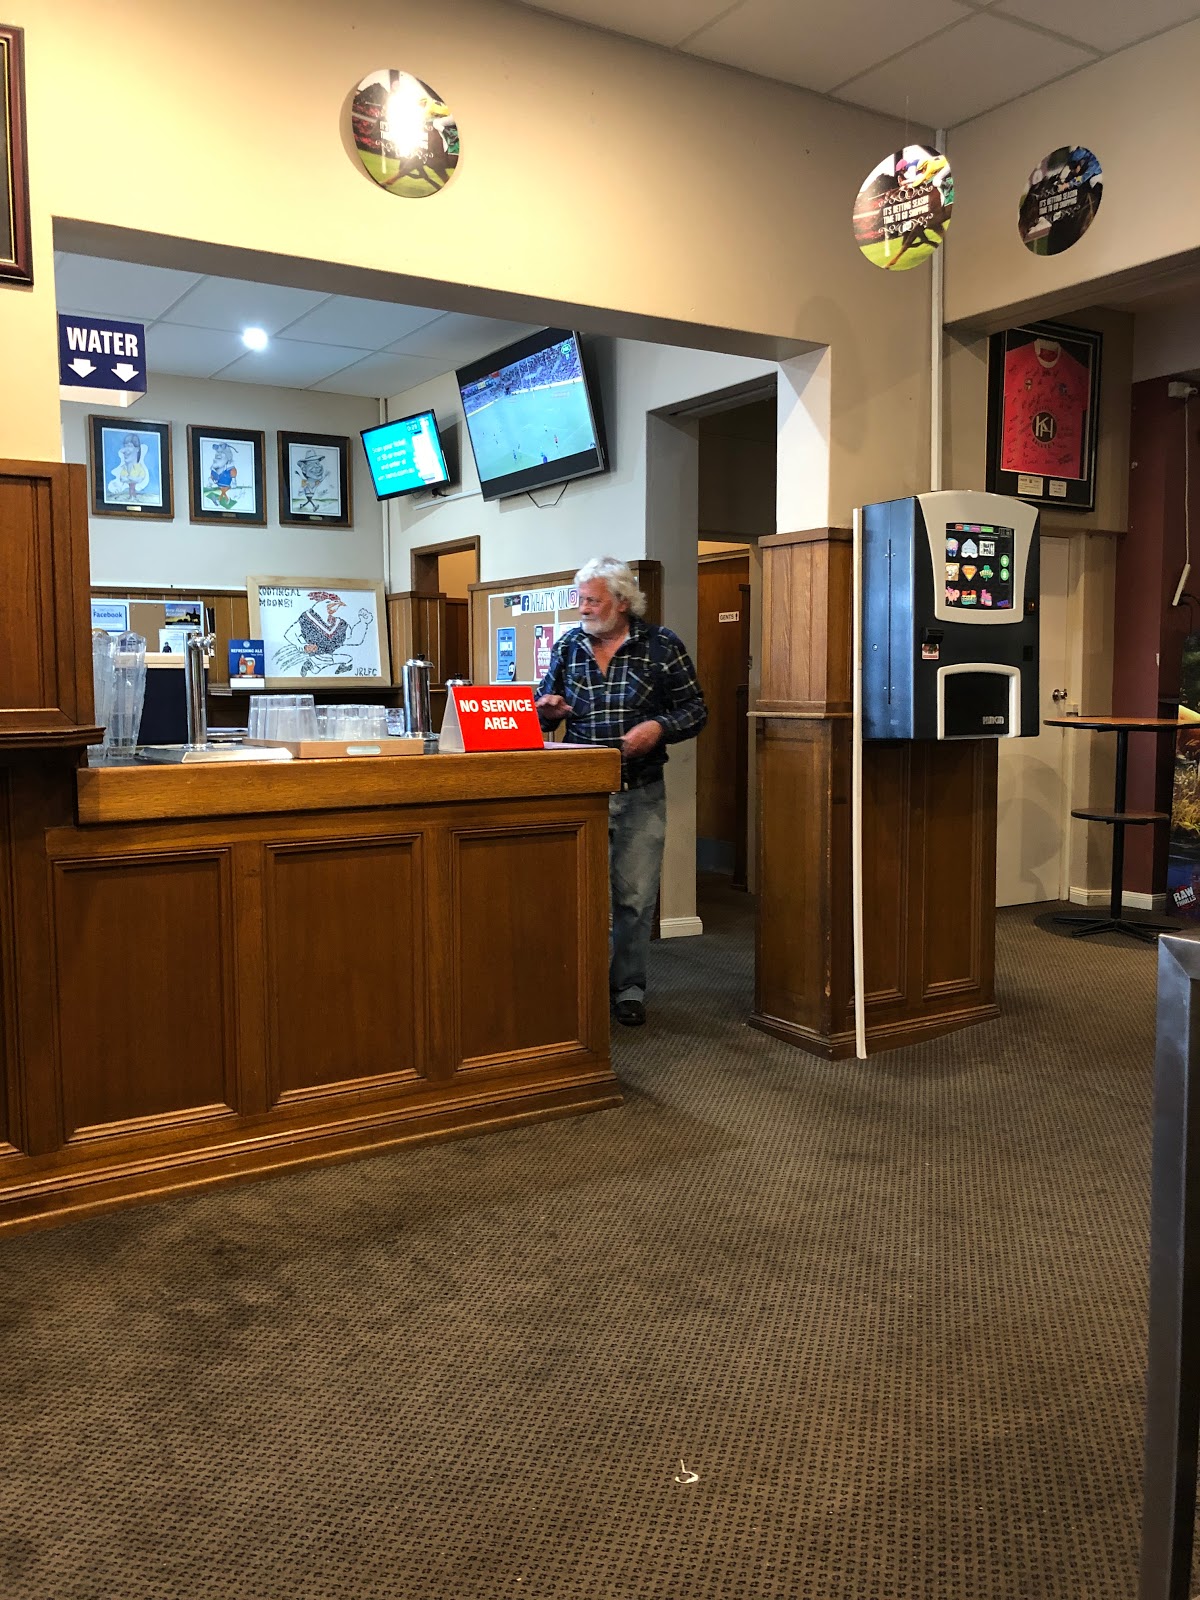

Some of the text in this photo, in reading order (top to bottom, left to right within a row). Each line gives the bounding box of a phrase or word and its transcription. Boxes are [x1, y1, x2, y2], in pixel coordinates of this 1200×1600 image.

[66, 326, 139, 358] WATER
[531, 592, 555, 612] WHAT'S
[459, 699, 533, 713] NO SERVICE
[484, 717, 519, 730] AREA
[1173, 886, 1194, 903] RAW
